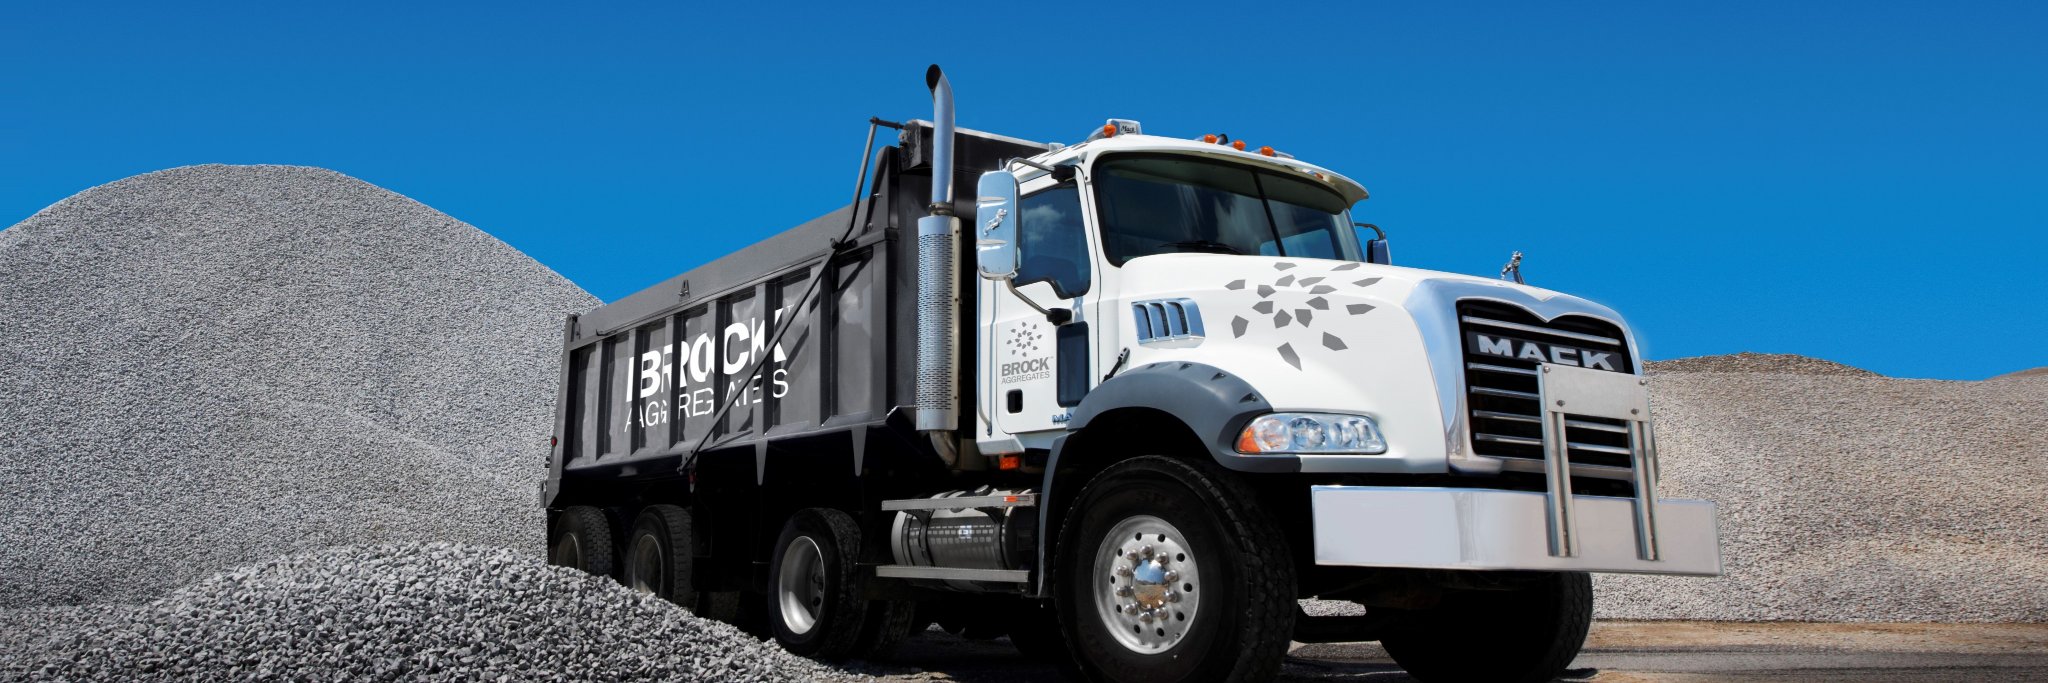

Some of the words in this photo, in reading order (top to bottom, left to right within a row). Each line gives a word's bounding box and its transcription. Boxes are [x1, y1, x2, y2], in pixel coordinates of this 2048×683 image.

[626, 308, 788, 403] BROCK
[1477, 335, 1615, 371] MACK
[1001, 356, 1050, 377] BROCK
[1001, 371, 1050, 384] AGGREGATES
[1052, 413, 1072, 422] MA
